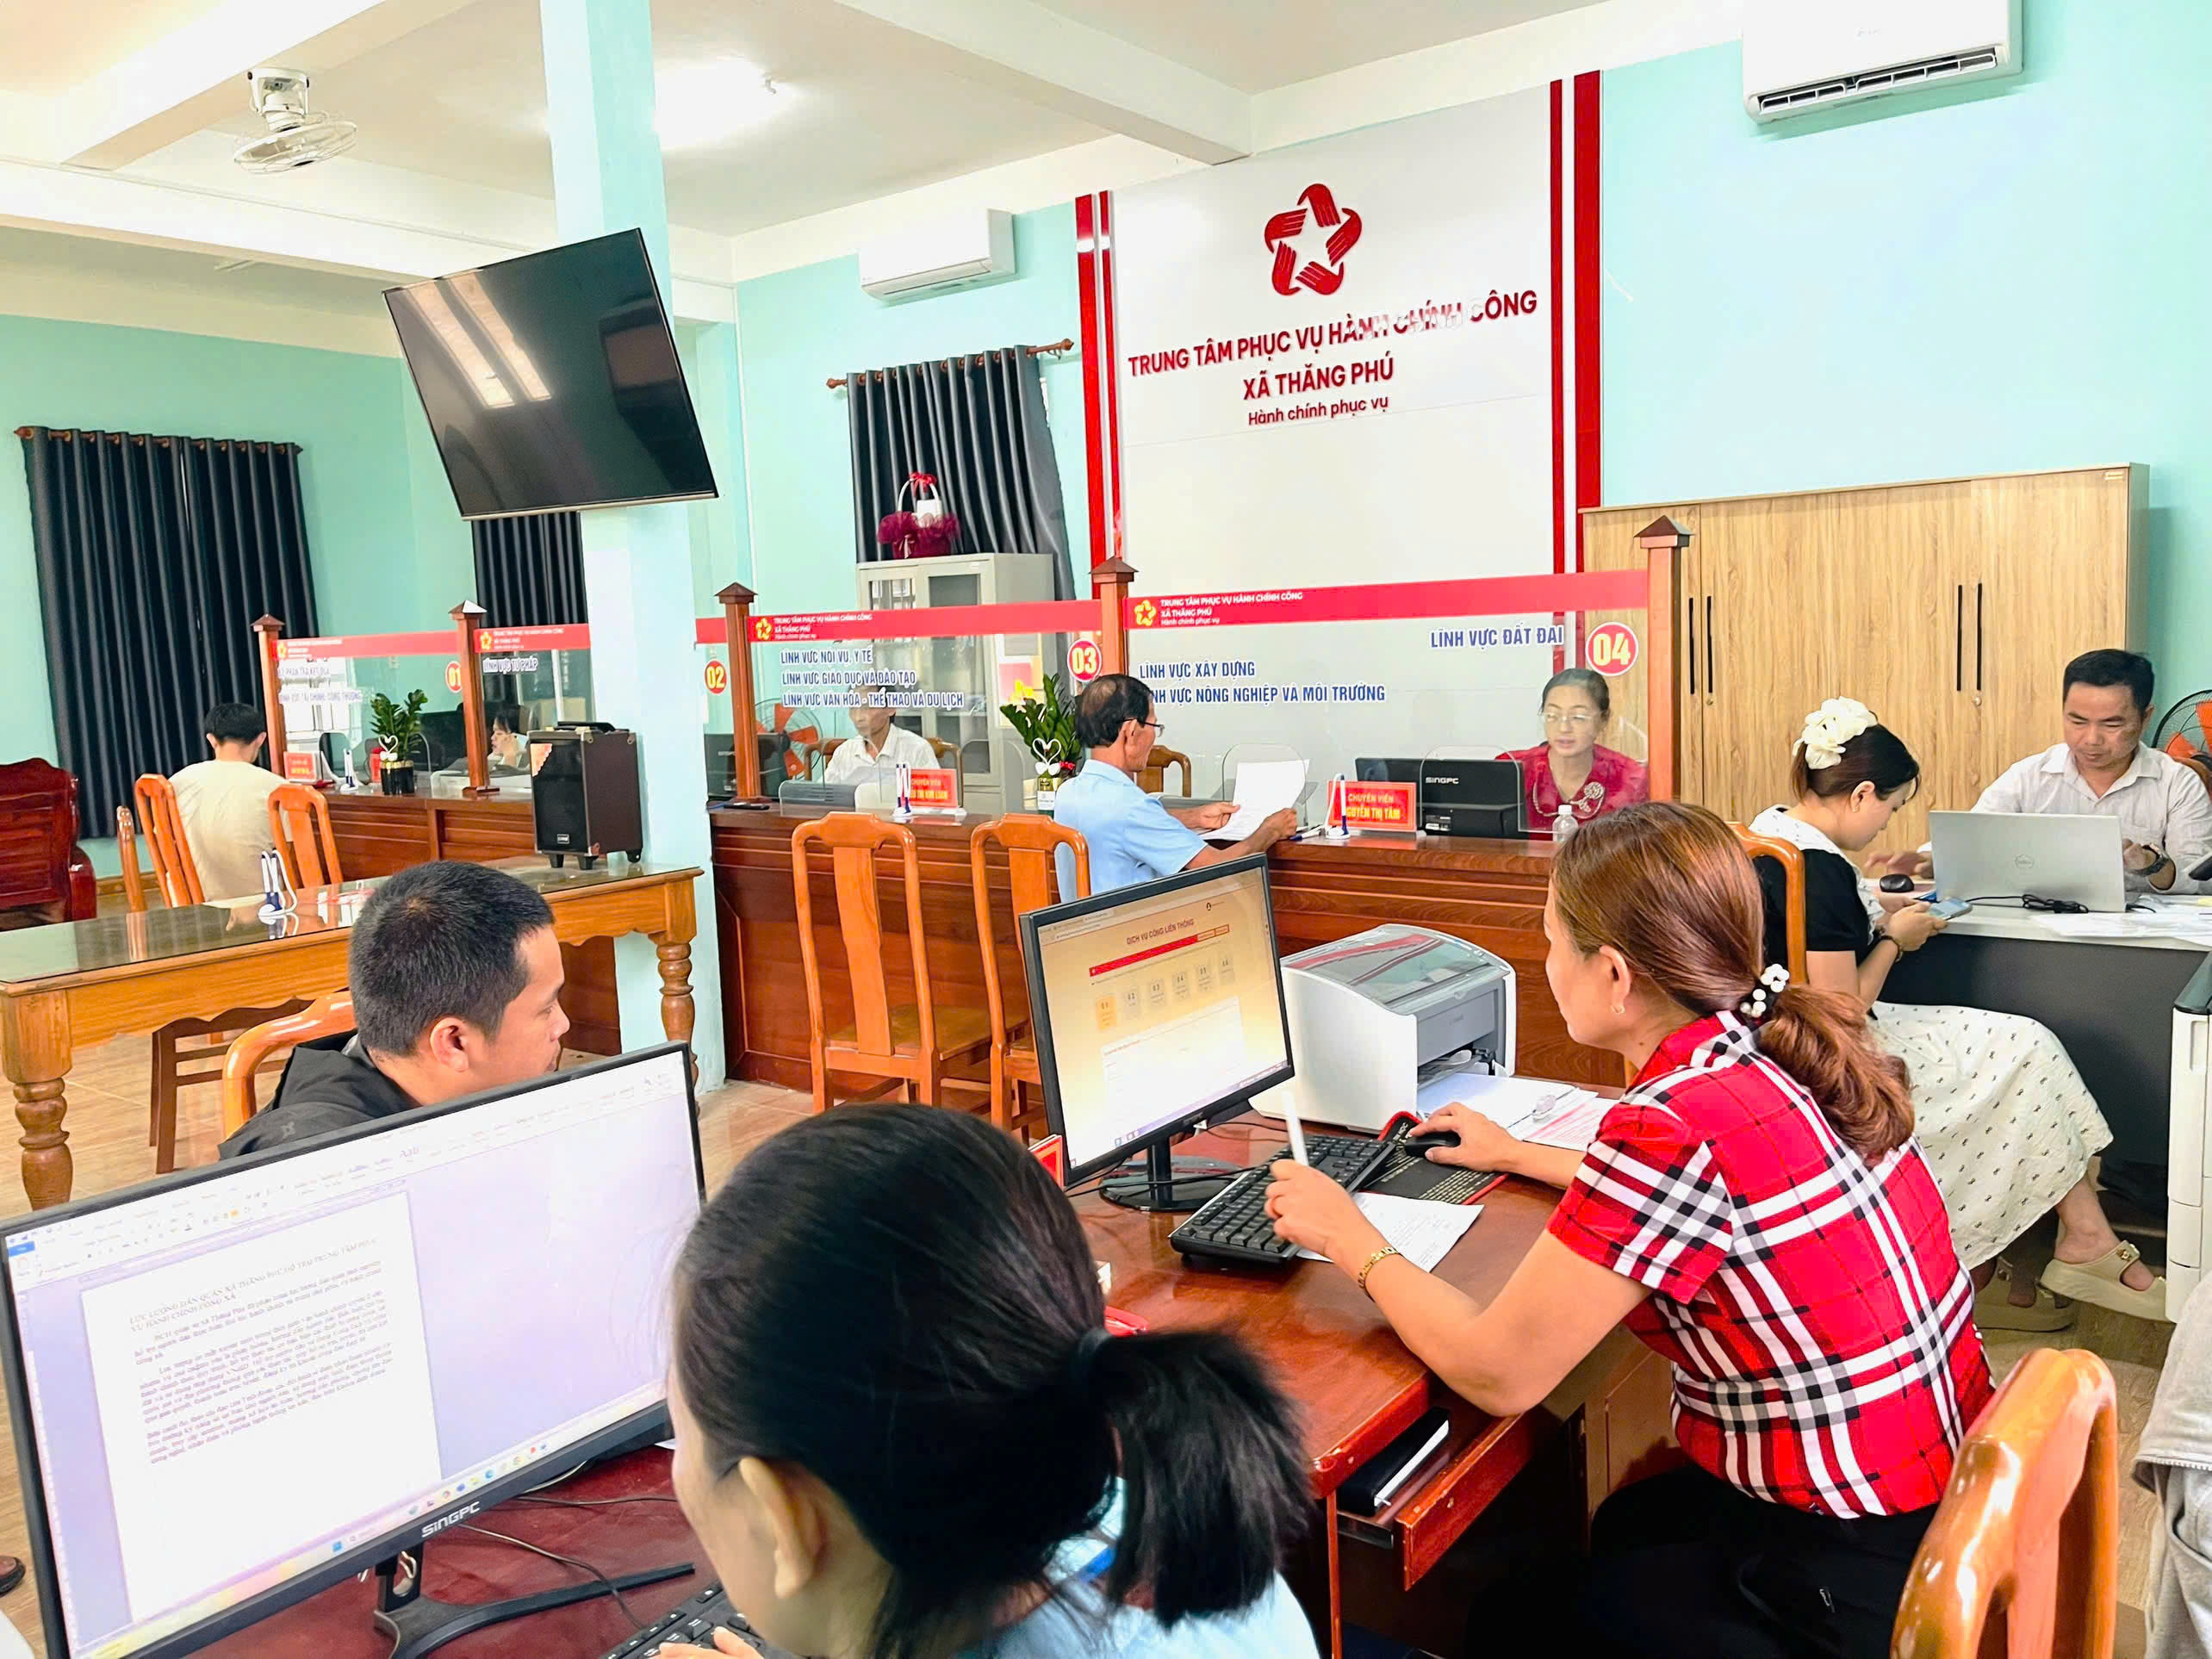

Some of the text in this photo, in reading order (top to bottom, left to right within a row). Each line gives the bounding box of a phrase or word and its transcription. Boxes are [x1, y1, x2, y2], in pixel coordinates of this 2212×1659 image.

[1128, 347, 1190, 376] TRUNG
[1193, 338, 1232, 365] TÂM
[1238, 331, 1290, 361] PHỤC
[1296, 326, 1323, 354] VỤ
[1243, 351, 1393, 400] XÃ THĂNG PHÚ
[1249, 397, 1389, 426] Hành chính phục vụ
[1160, 599, 1184, 607] TRUNG
[1185, 597, 1199, 606] TÂM
[1201, 597, 1221, 607] PHỤC
[1233, 593, 1255, 603] HÀNH
[1256, 593, 1280, 602] CHÍNH
[1281, 592, 1302, 600] CÔNG
[1171, 608, 1196, 618] THĂNG
[1196, 606, 1213, 616] PHÚ
[1431, 622, 1563, 649] LĨNH VỰC ĐẤT ĐAI
[854, 650, 860, 662] Y
[1594, 632, 1631, 666] 04
[1072, 647, 1097, 674] 03
[1169, 662, 1191, 680] VỰC
[1221, 661, 1255, 680] DỰNG
[449, 667, 461, 687] 01
[706, 666, 726, 688] 02
[927, 693, 940, 706] DU
[1150, 688, 1165, 703] NH
[1170, 688, 1191, 706] VỰC
[1233, 685, 1277, 706] NGHIỆP
[1345, 805, 1370, 817] GUYỄN
[421, 1501, 481, 1538] SINGPC
